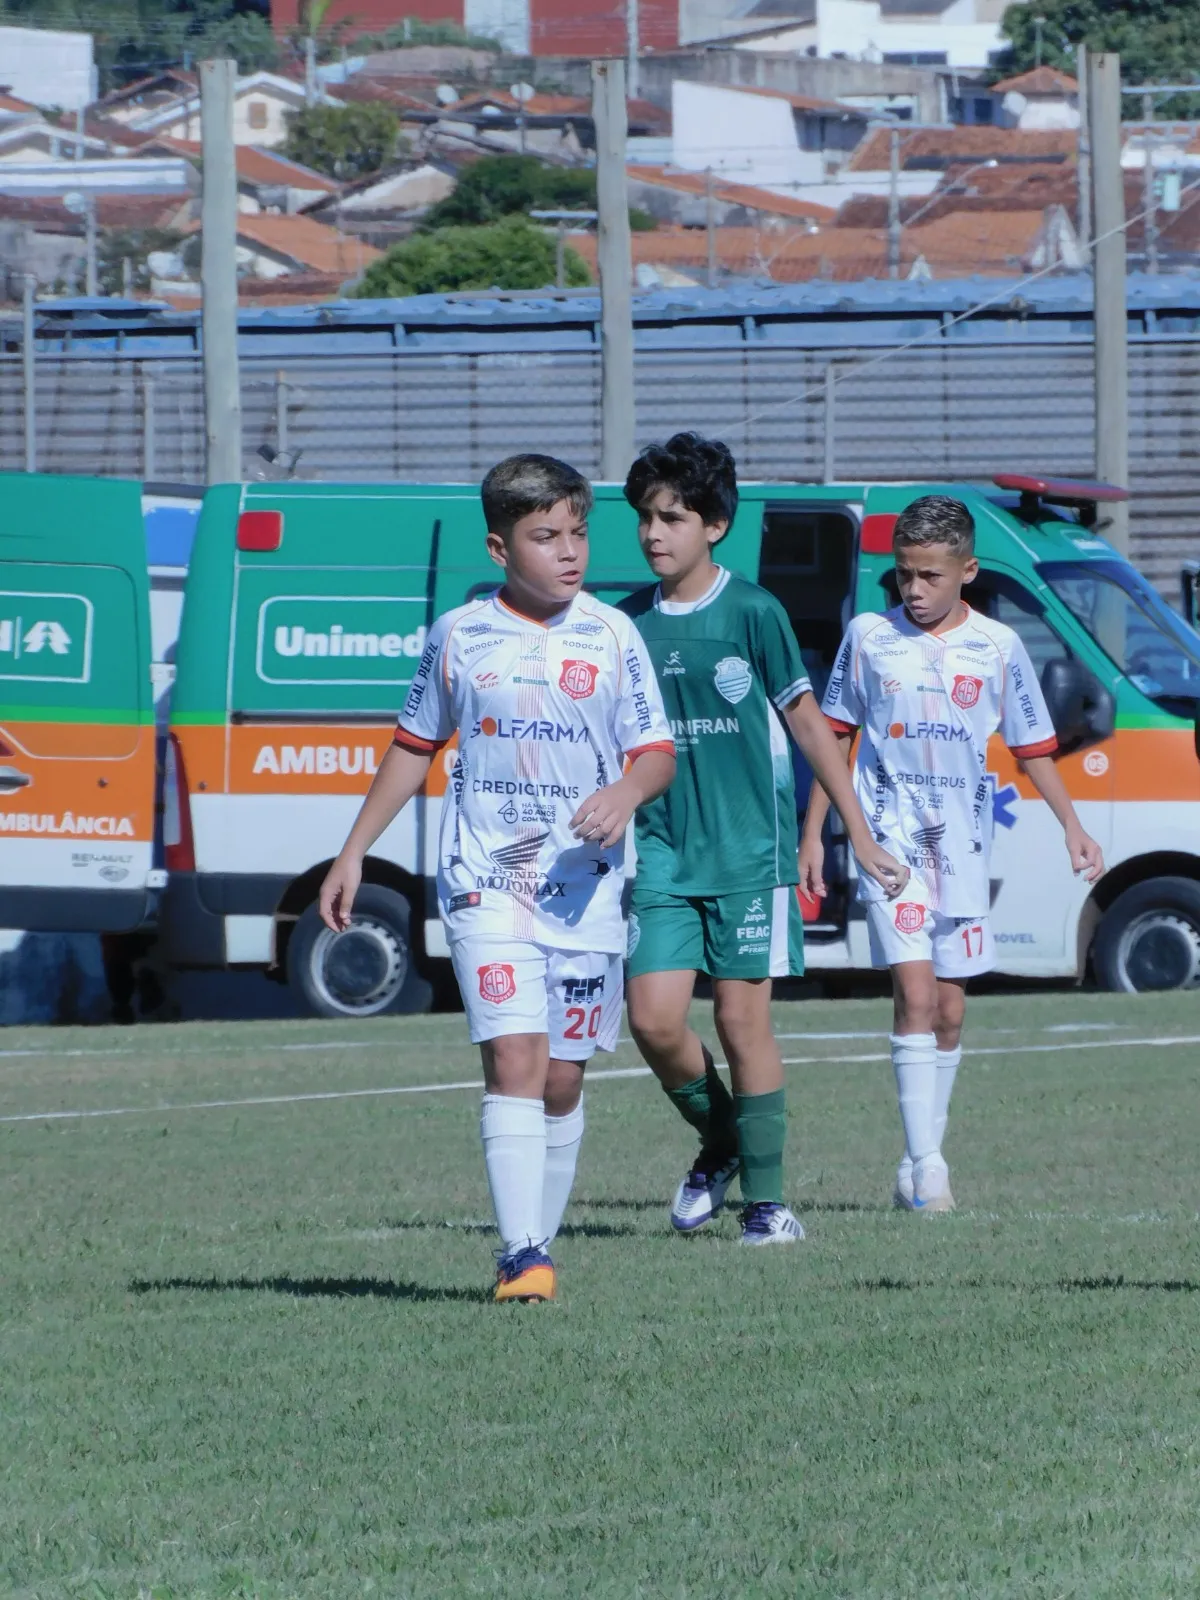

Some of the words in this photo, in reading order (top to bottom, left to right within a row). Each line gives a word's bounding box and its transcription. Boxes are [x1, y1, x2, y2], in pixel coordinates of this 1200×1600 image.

[274, 624, 427, 658] Unimed
[463, 638, 505, 656] RODOCAP
[562, 639, 604, 653] RODOCAP
[404, 682, 427, 719] LEGAL
[417, 641, 440, 681] PERFIL
[826, 676, 845, 706] LEGAL
[632, 691, 653, 735] PERFIL
[1019, 693, 1039, 730] PERFIL
[470, 716, 590, 744] SOLFARMA
[472, 779, 580, 800] CREDICITRUS
[0, 811, 135, 837] MBULÂNCIA
[872, 799, 885, 823] BOI
[476, 875, 567, 897] MOTOMAX
[492, 866, 550, 880] HONDA
[736, 925, 770, 940] FEAC
[961, 925, 983, 958] 17
[563, 1004, 602, 1040] 20
